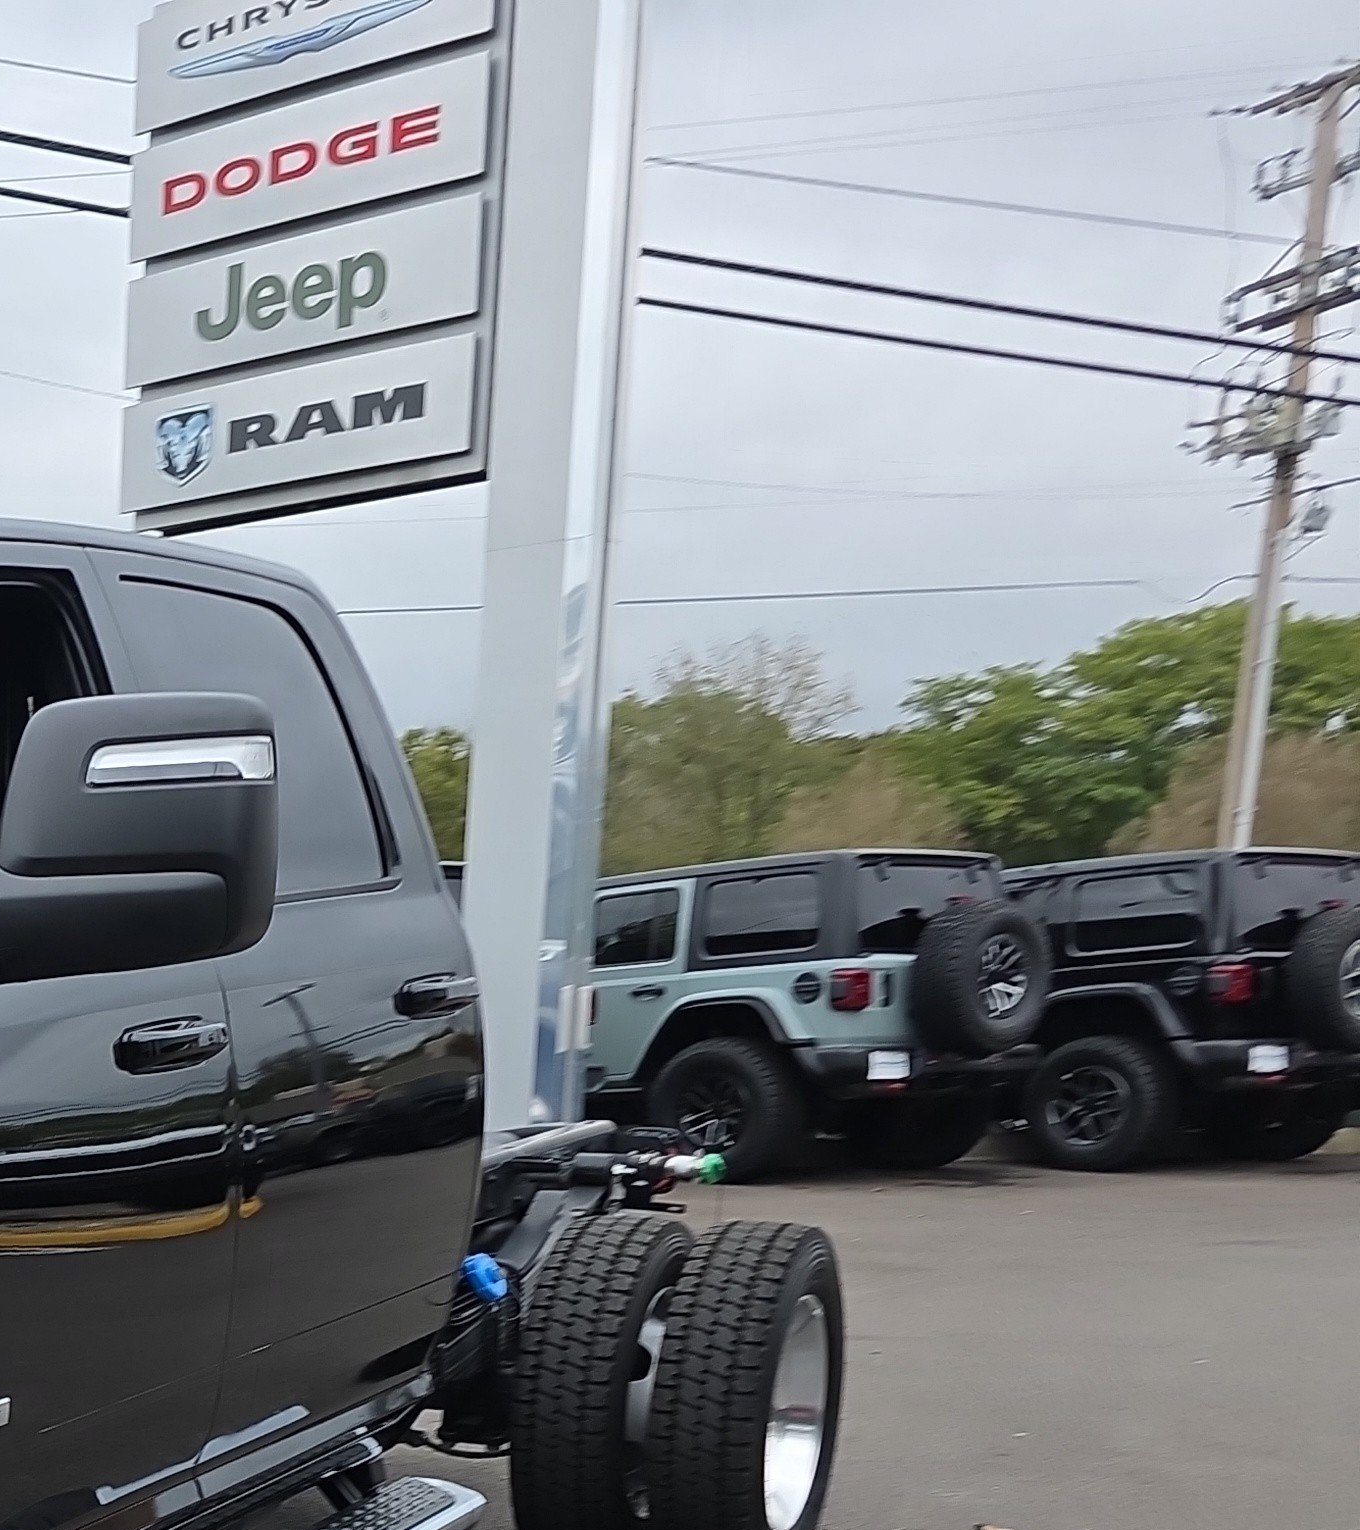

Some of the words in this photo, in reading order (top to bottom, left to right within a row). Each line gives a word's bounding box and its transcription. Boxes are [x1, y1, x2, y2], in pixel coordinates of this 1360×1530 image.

[161, 104, 442, 216] DODGE
[195, 249, 387, 341] Jeep
[228, 381, 428, 455] RAM
